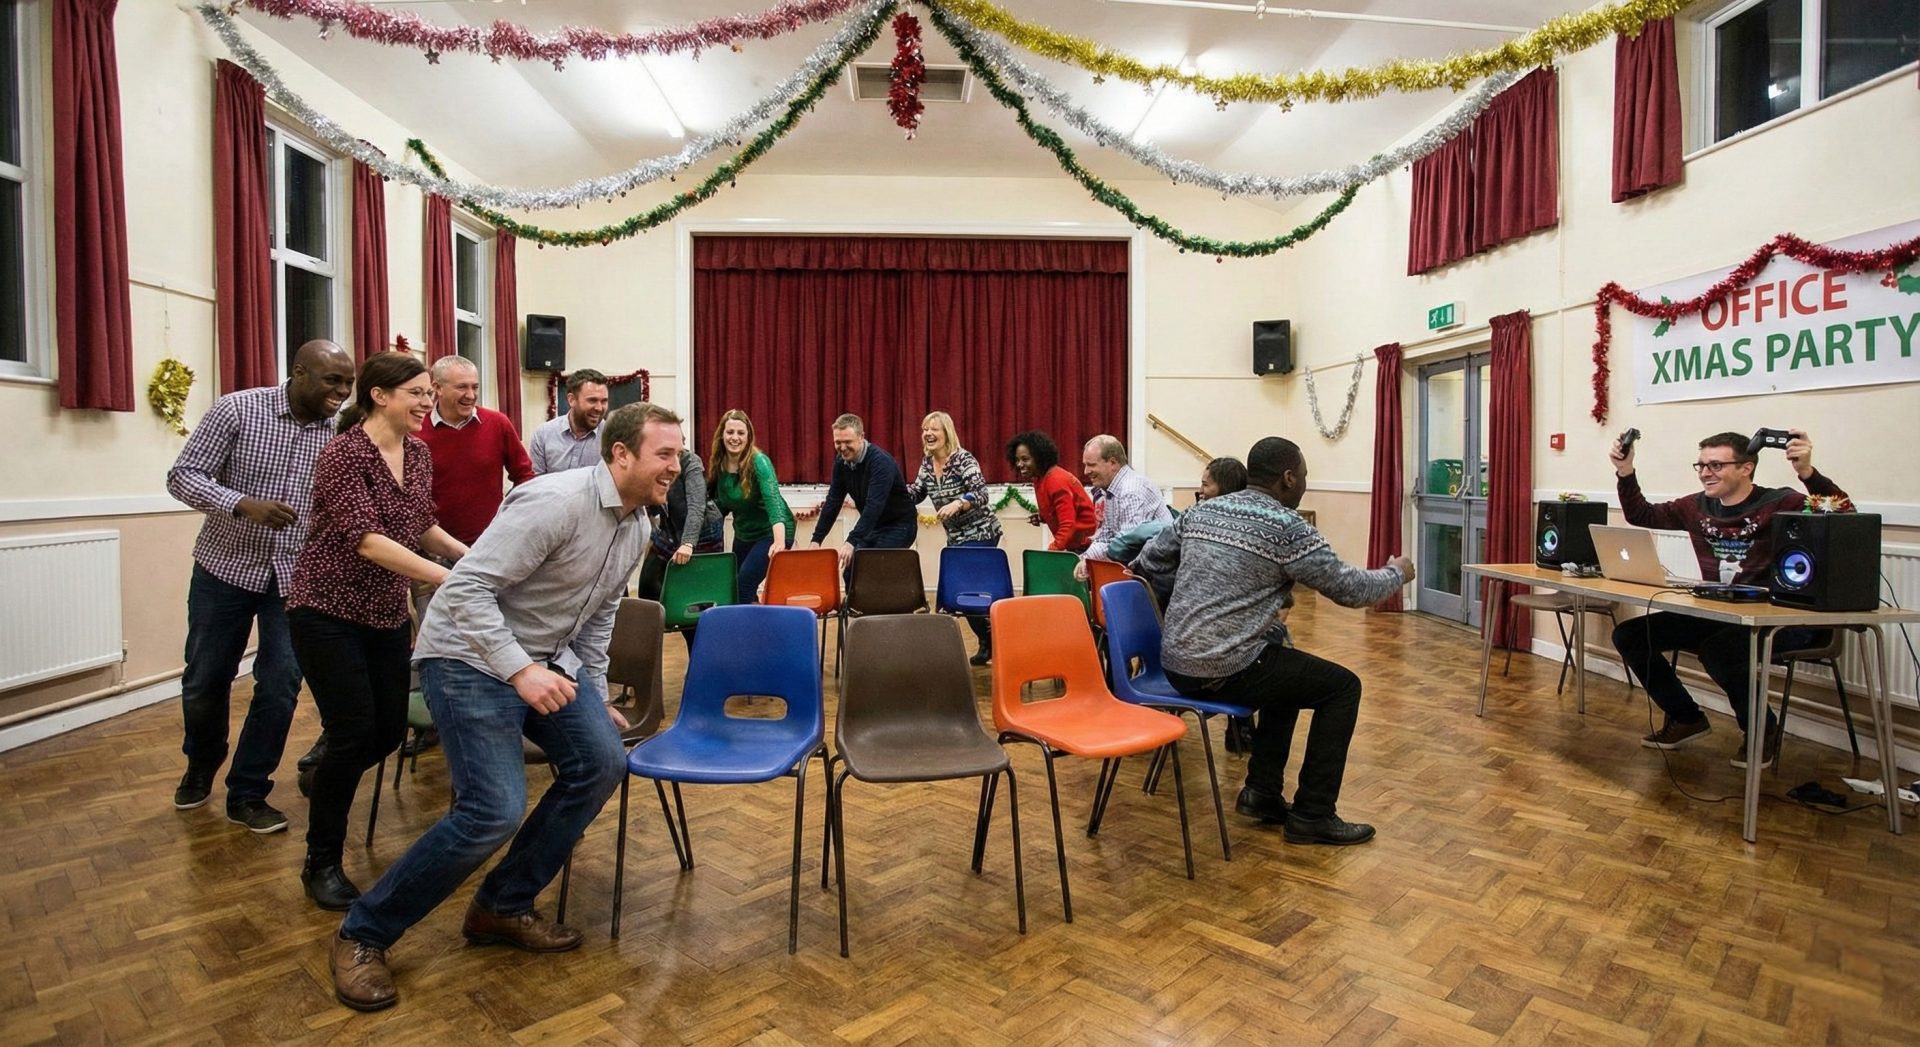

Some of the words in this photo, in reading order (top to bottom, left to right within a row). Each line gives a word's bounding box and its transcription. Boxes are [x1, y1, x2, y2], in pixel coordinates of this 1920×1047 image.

[1701, 269, 1848, 332] OFFICE
[1651, 337, 1754, 385] XMAS
[1766, 312, 1920, 372] PARTY
